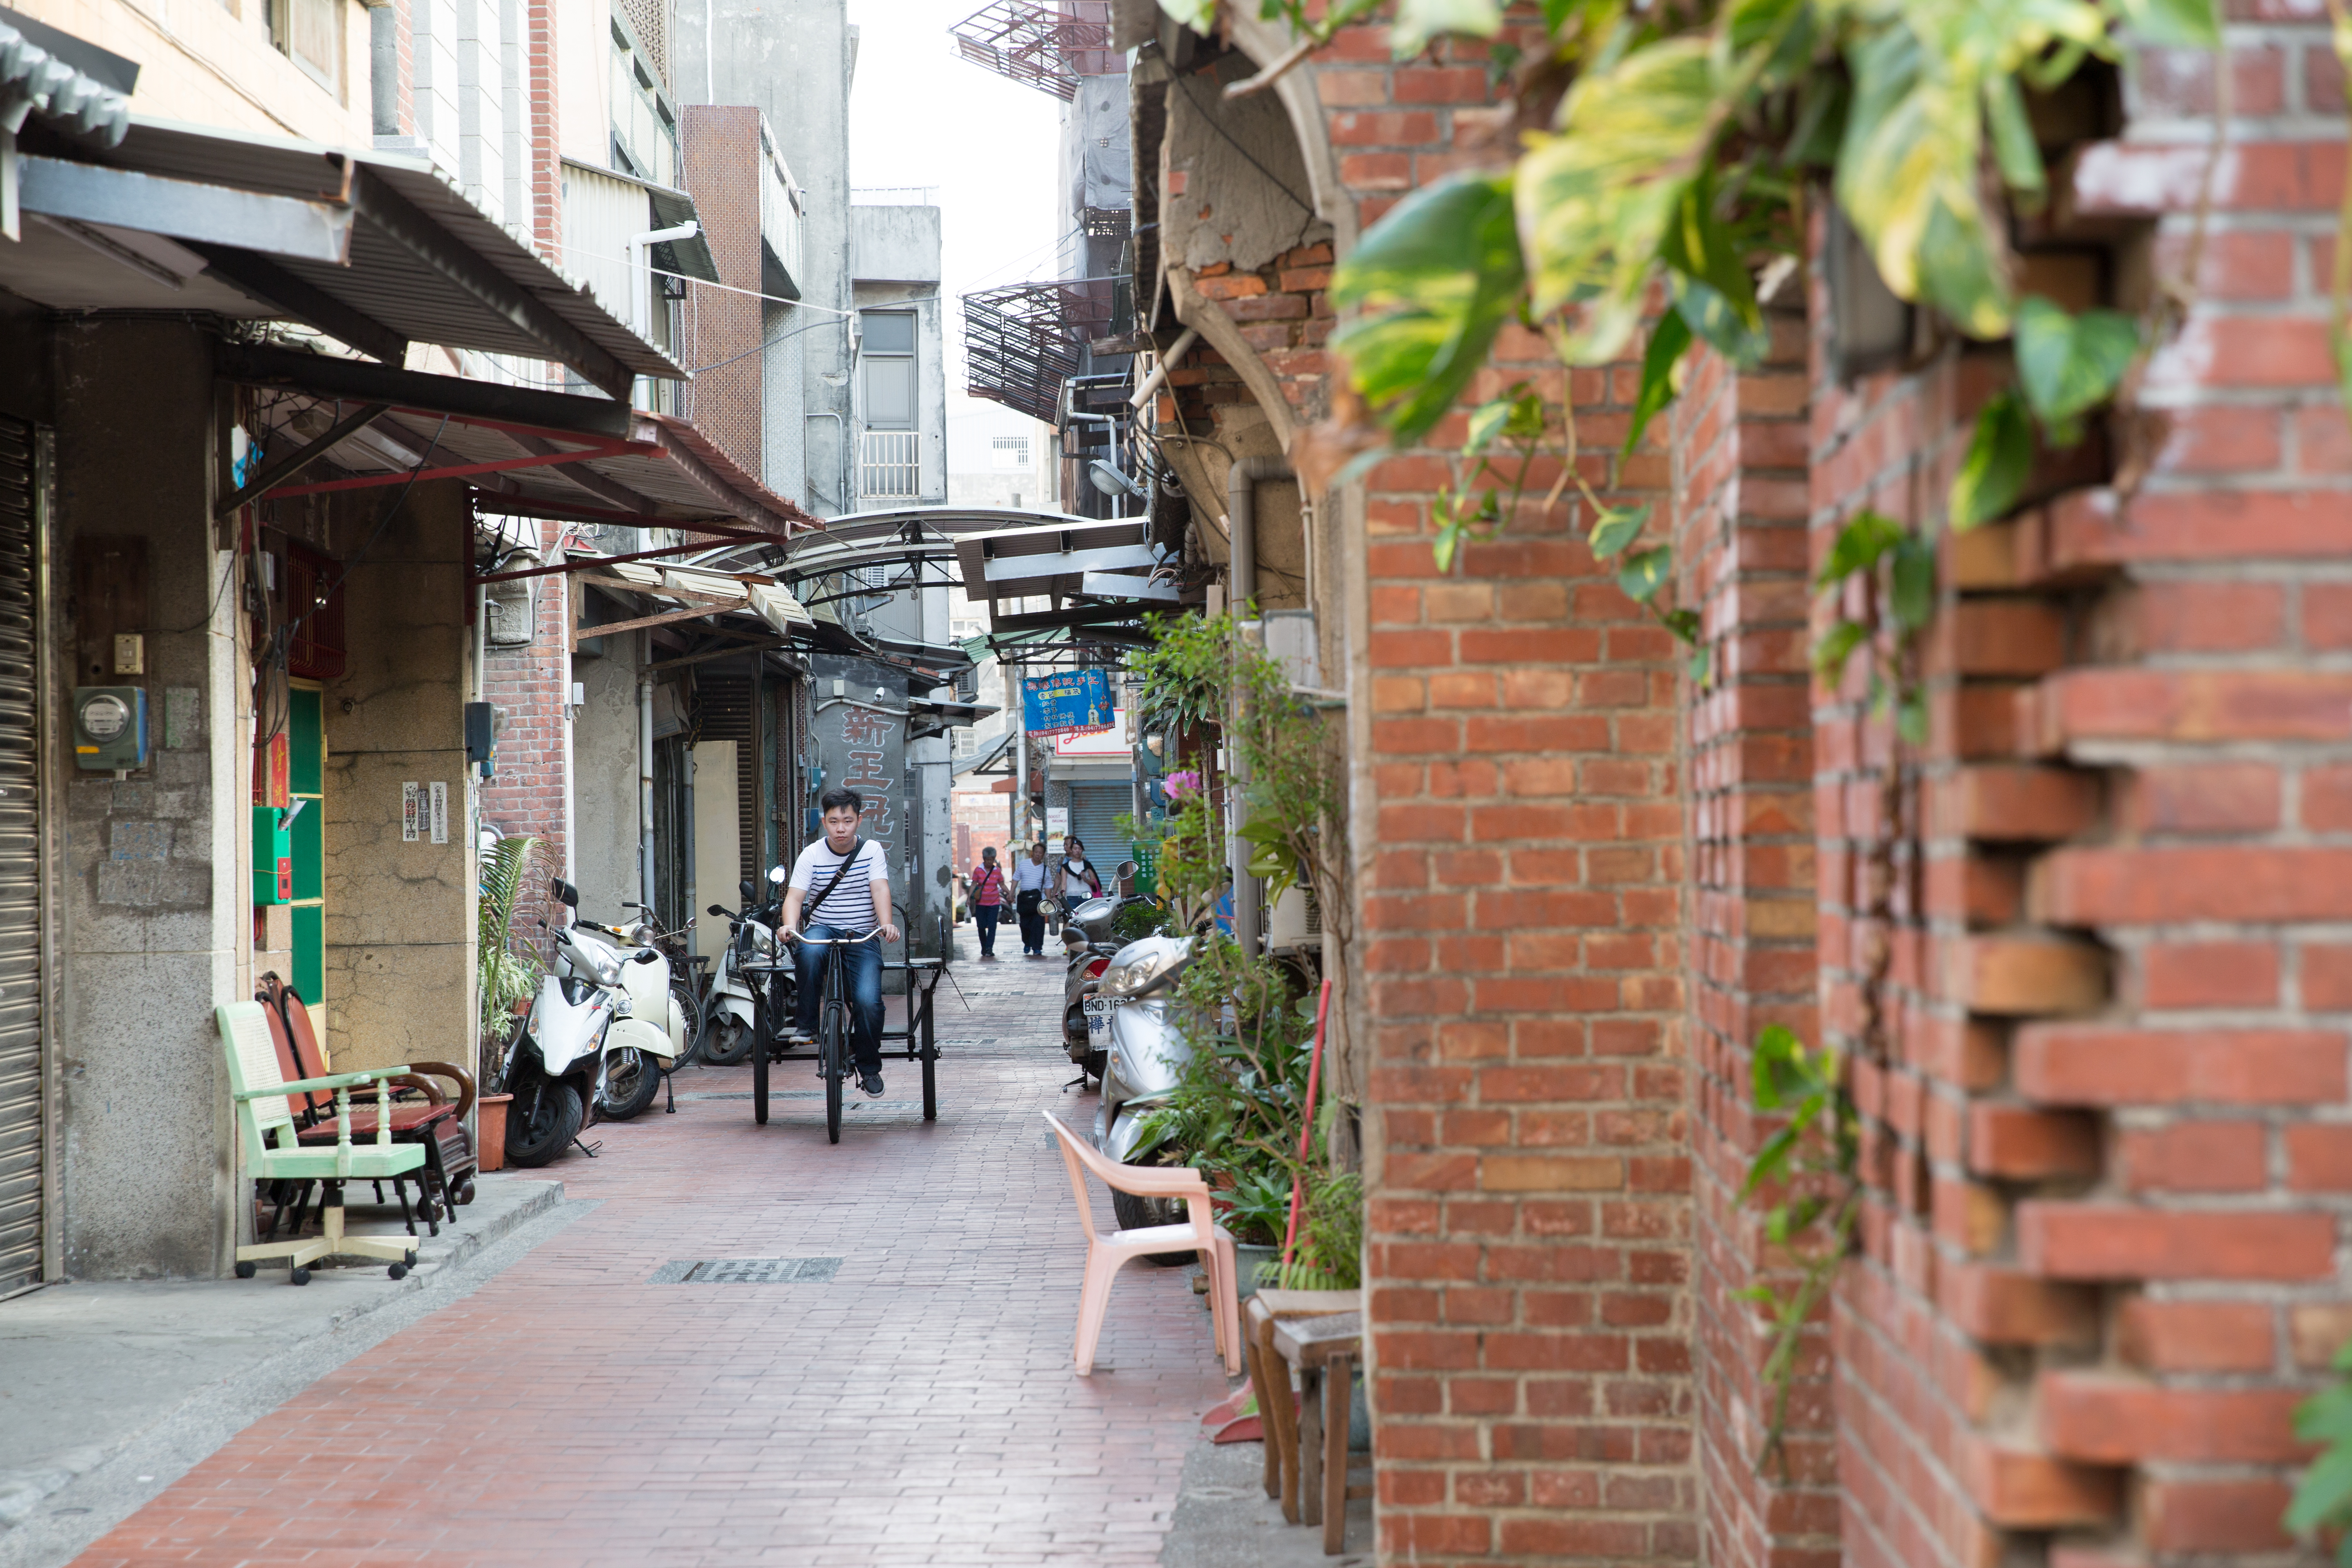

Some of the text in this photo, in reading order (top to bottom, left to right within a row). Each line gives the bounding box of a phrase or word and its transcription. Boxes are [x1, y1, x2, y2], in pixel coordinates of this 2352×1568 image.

[1027, 677, 1100, 691] 鹿港傳統手工
[1044, 712, 1074, 722] 材料供應
